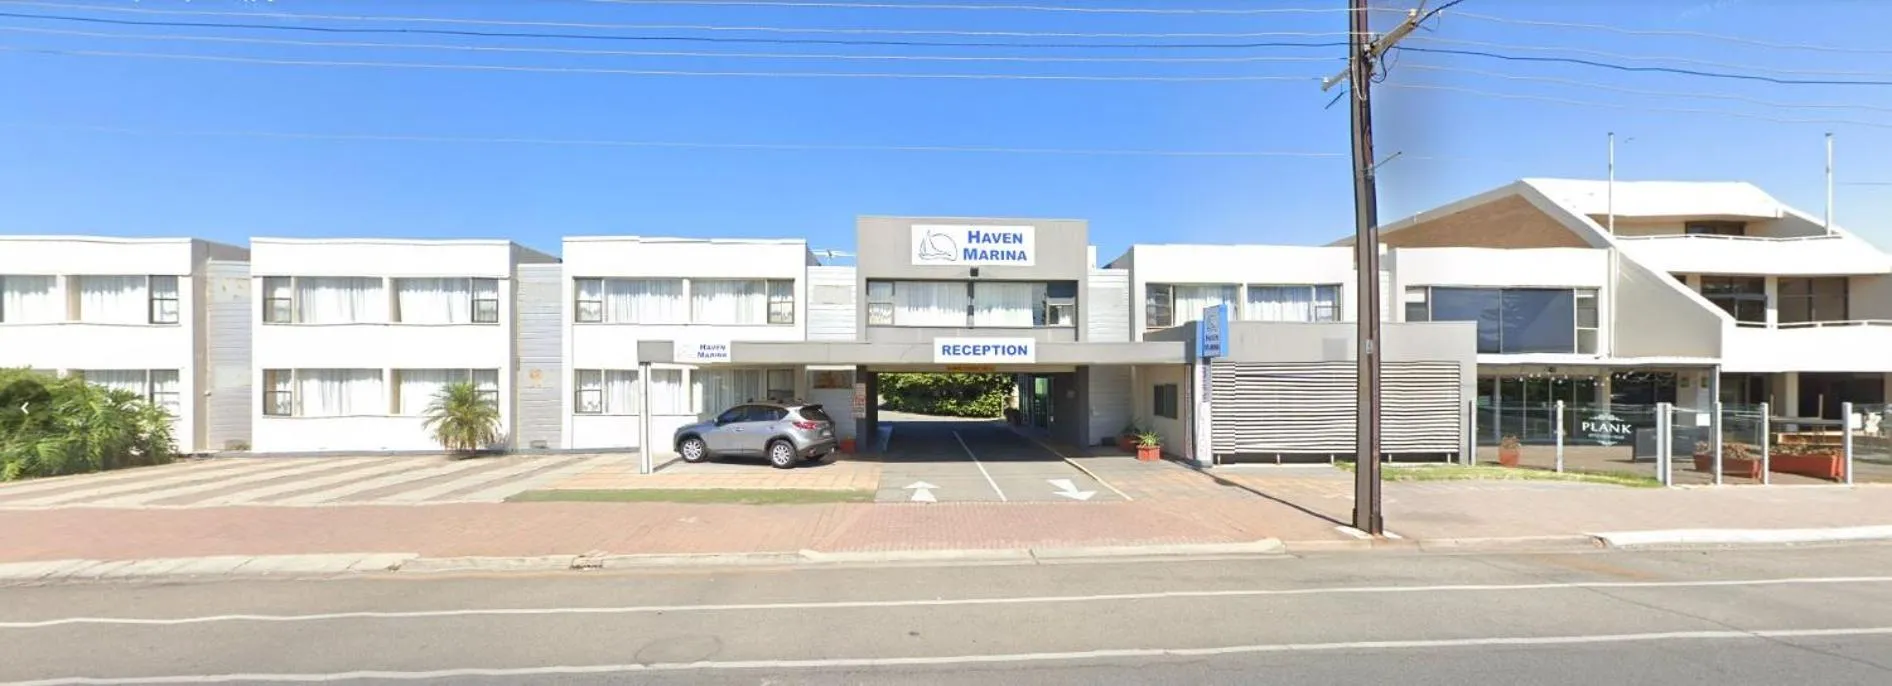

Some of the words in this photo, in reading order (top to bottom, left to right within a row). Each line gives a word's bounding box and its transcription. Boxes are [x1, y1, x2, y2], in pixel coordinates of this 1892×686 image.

[968, 230, 1023, 244] HAVEN
[963, 248, 1027, 261] MARINA
[942, 344, 1028, 356] RECEPTION
[1582, 421, 1632, 434] PLANK
